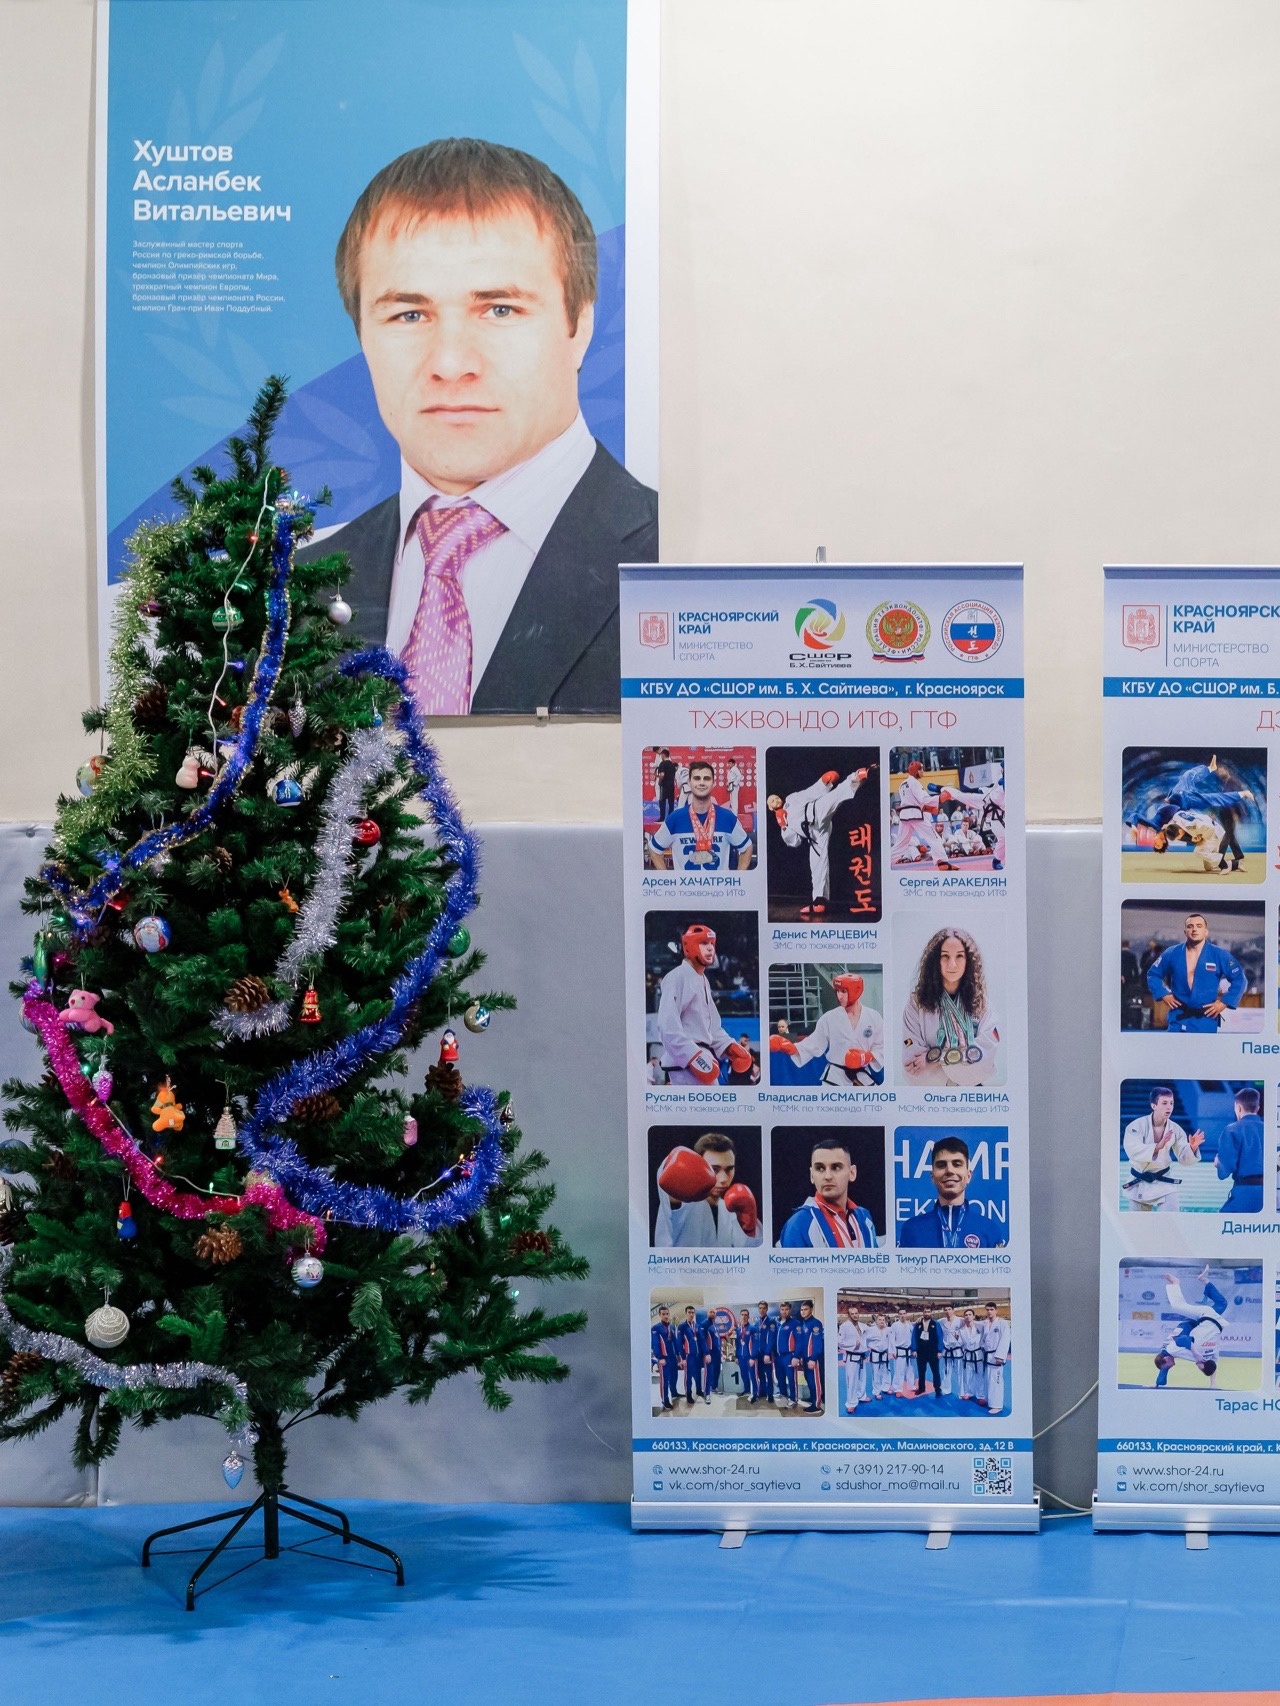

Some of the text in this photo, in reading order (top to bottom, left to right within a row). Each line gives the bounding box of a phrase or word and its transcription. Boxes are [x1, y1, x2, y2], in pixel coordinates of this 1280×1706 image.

[133, 140, 233, 167] Хуштов
[132, 170, 262, 192] Асланбек
[134, 200, 291, 222] Витальевич
[133, 240, 186, 250] Заслуженный
[678, 610, 779, 622] КРАСНОЯРСКИЙ
[678, 622, 711, 634] КРАЙ
[1174, 621, 1215, 633] КРАЙ
[678, 642, 754, 650] МИНИСТЕРСТВО
[1173, 642, 1270, 654] МИНИСТЕРСТВО
[679, 652, 716, 662] СПОРТА
[1173, 656, 1220, 668] СПОРТА
[640, 682, 1005, 697] КГБУ ДО «СШОР им. Б. Х. Сайтиева», г. Красноярск
[1122, 682, 1156, 694] КГБУ
[1158, 682, 1182, 696] ДО
[1185, 682, 1237, 695] «СШОР
[1240, 685, 1264, 695] им.
[1268, 682, 1280, 695] Б.
[688, 710, 957, 732] ТХЭКВОНДО ИТФ, ГТФ
[848, 823, 878, 914] 태권도
[642, 877, 741, 889] Арсен ХАЧАТРЯН
[899, 877, 1007, 889] Сергей АРАКЕЛЯН
[772, 929, 878, 941] Денис МАРЦЕВИЧ
[645, 1092, 737, 1104] Руслан БОБОЕВ
[758, 1092, 897, 1103] Владислав ИСМАГИЛОВ
[924, 1093, 1010, 1103] Ольга ЛЕВИНА
[1221, 1221, 1280, 1235] Даниил
[647, 1254, 750, 1265] Даниил КАТАШИН
[768, 1252, 890, 1264] Константин МУРАВЬЁВ
[895, 1254, 1012, 1266] Тимур ПАРХОМЕНКО
[1215, 1398, 1259, 1414] Тарас
[652, 1441, 690, 1451] 660133,
[692, 1441, 770, 1452] Красноярский
[772, 1441, 801, 1452] край,
[811, 1441, 879, 1452] Красноярск,
[880, 1443, 895, 1452] ул.
[897, 1441, 977, 1451] Малиновского,
[979, 1441, 1006, 1452] зд.12
[1008, 1441, 1014, 1450] В
[668, 1464, 760, 1475] www.shor-24.ru
[836, 1464, 944, 1476] +7 (391) 217-90-14
[668, 1480, 801, 1493] vk.com/shor_saytieva
[836, 1480, 960, 1492] sdushor_mo@mail.ru
[1132, 1481, 1265, 1495] vk.com/shor_saytieva
